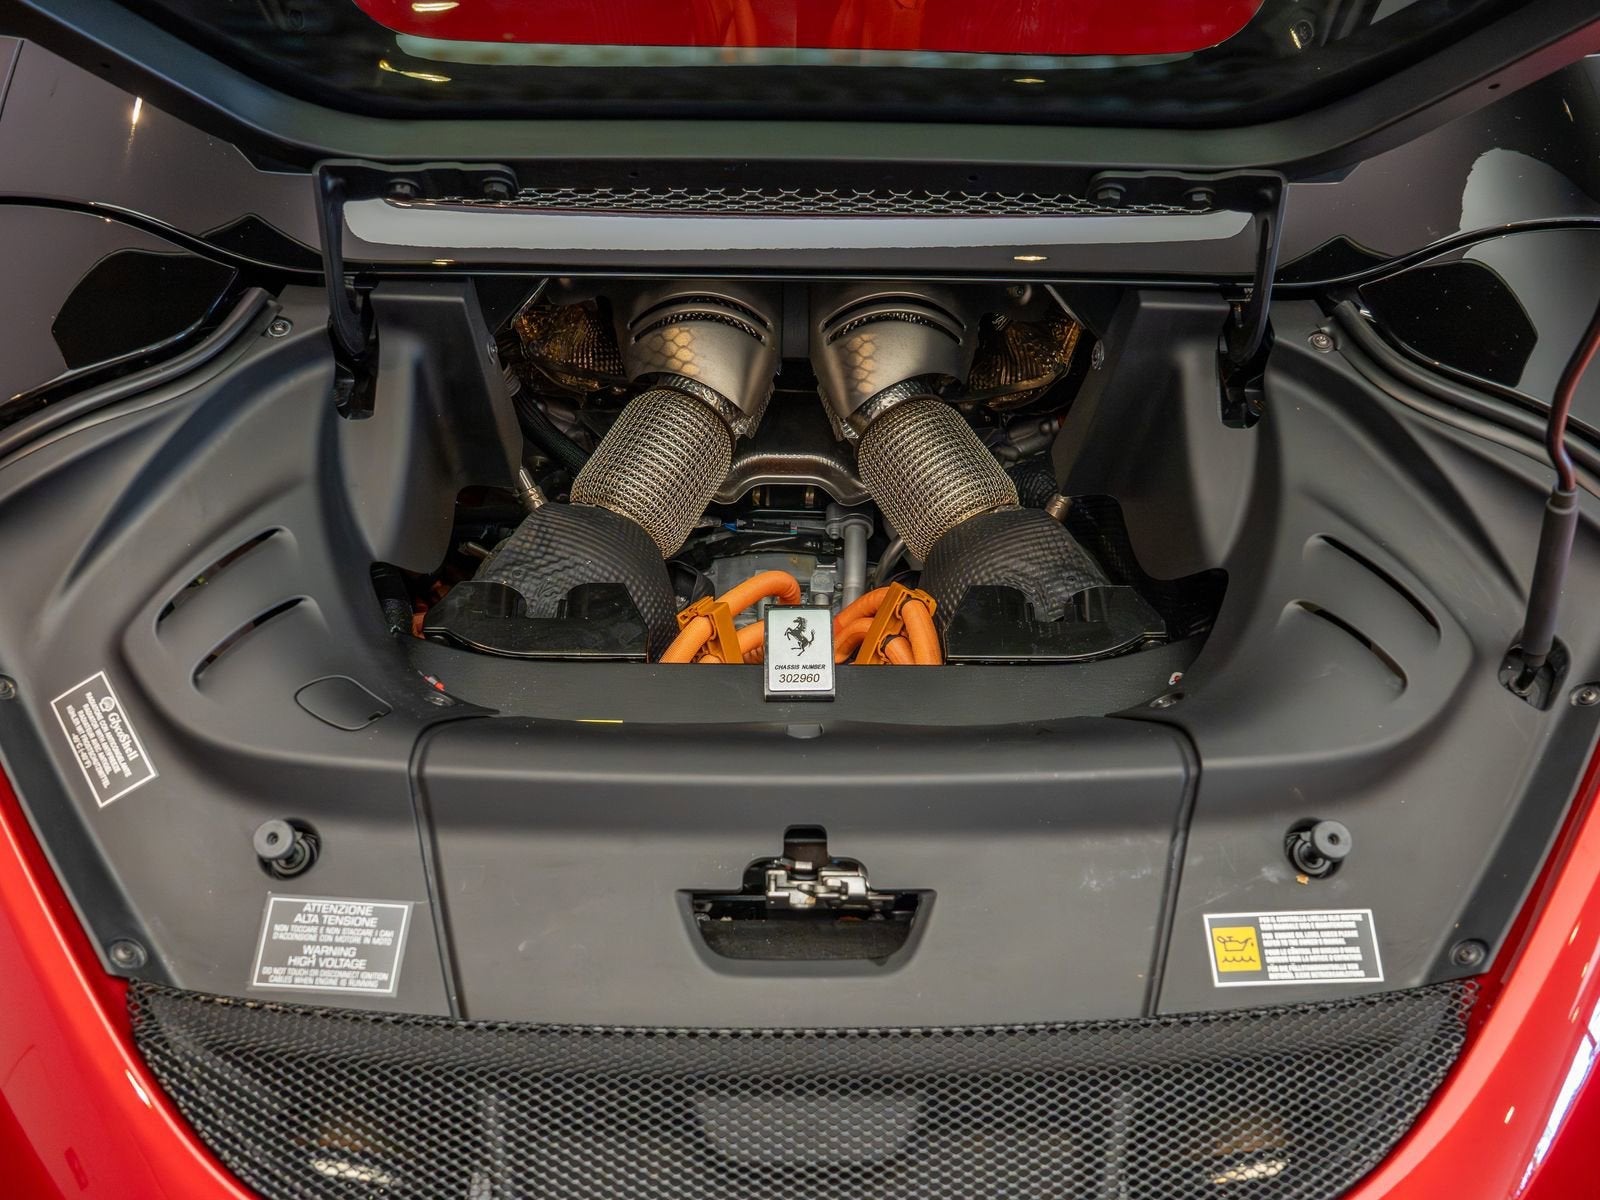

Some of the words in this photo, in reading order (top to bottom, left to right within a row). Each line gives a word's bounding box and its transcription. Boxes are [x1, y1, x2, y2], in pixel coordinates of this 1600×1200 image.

[779, 674, 820, 683] 302960
[108, 712, 139, 761] GlycoShell
[303, 903, 374, 915] ATTENZIONE
[294, 914, 319, 924] ALTA
[322, 916, 378, 927] TENSIONE
[290, 925, 319, 933] TOCCARE
[342, 928, 374, 936] STACCARE
[334, 935, 361, 944] MOTORE
[371, 938, 392, 946] MOTO
[302, 945, 357, 956] WARNING
[288, 956, 317, 966] HIGH
[318, 958, 367, 969] VOLTAGE
[287, 968, 309, 976] TOUCH
[320, 970, 359, 979] DISCONNECT
[348, 980, 378, 988] RUNNING
